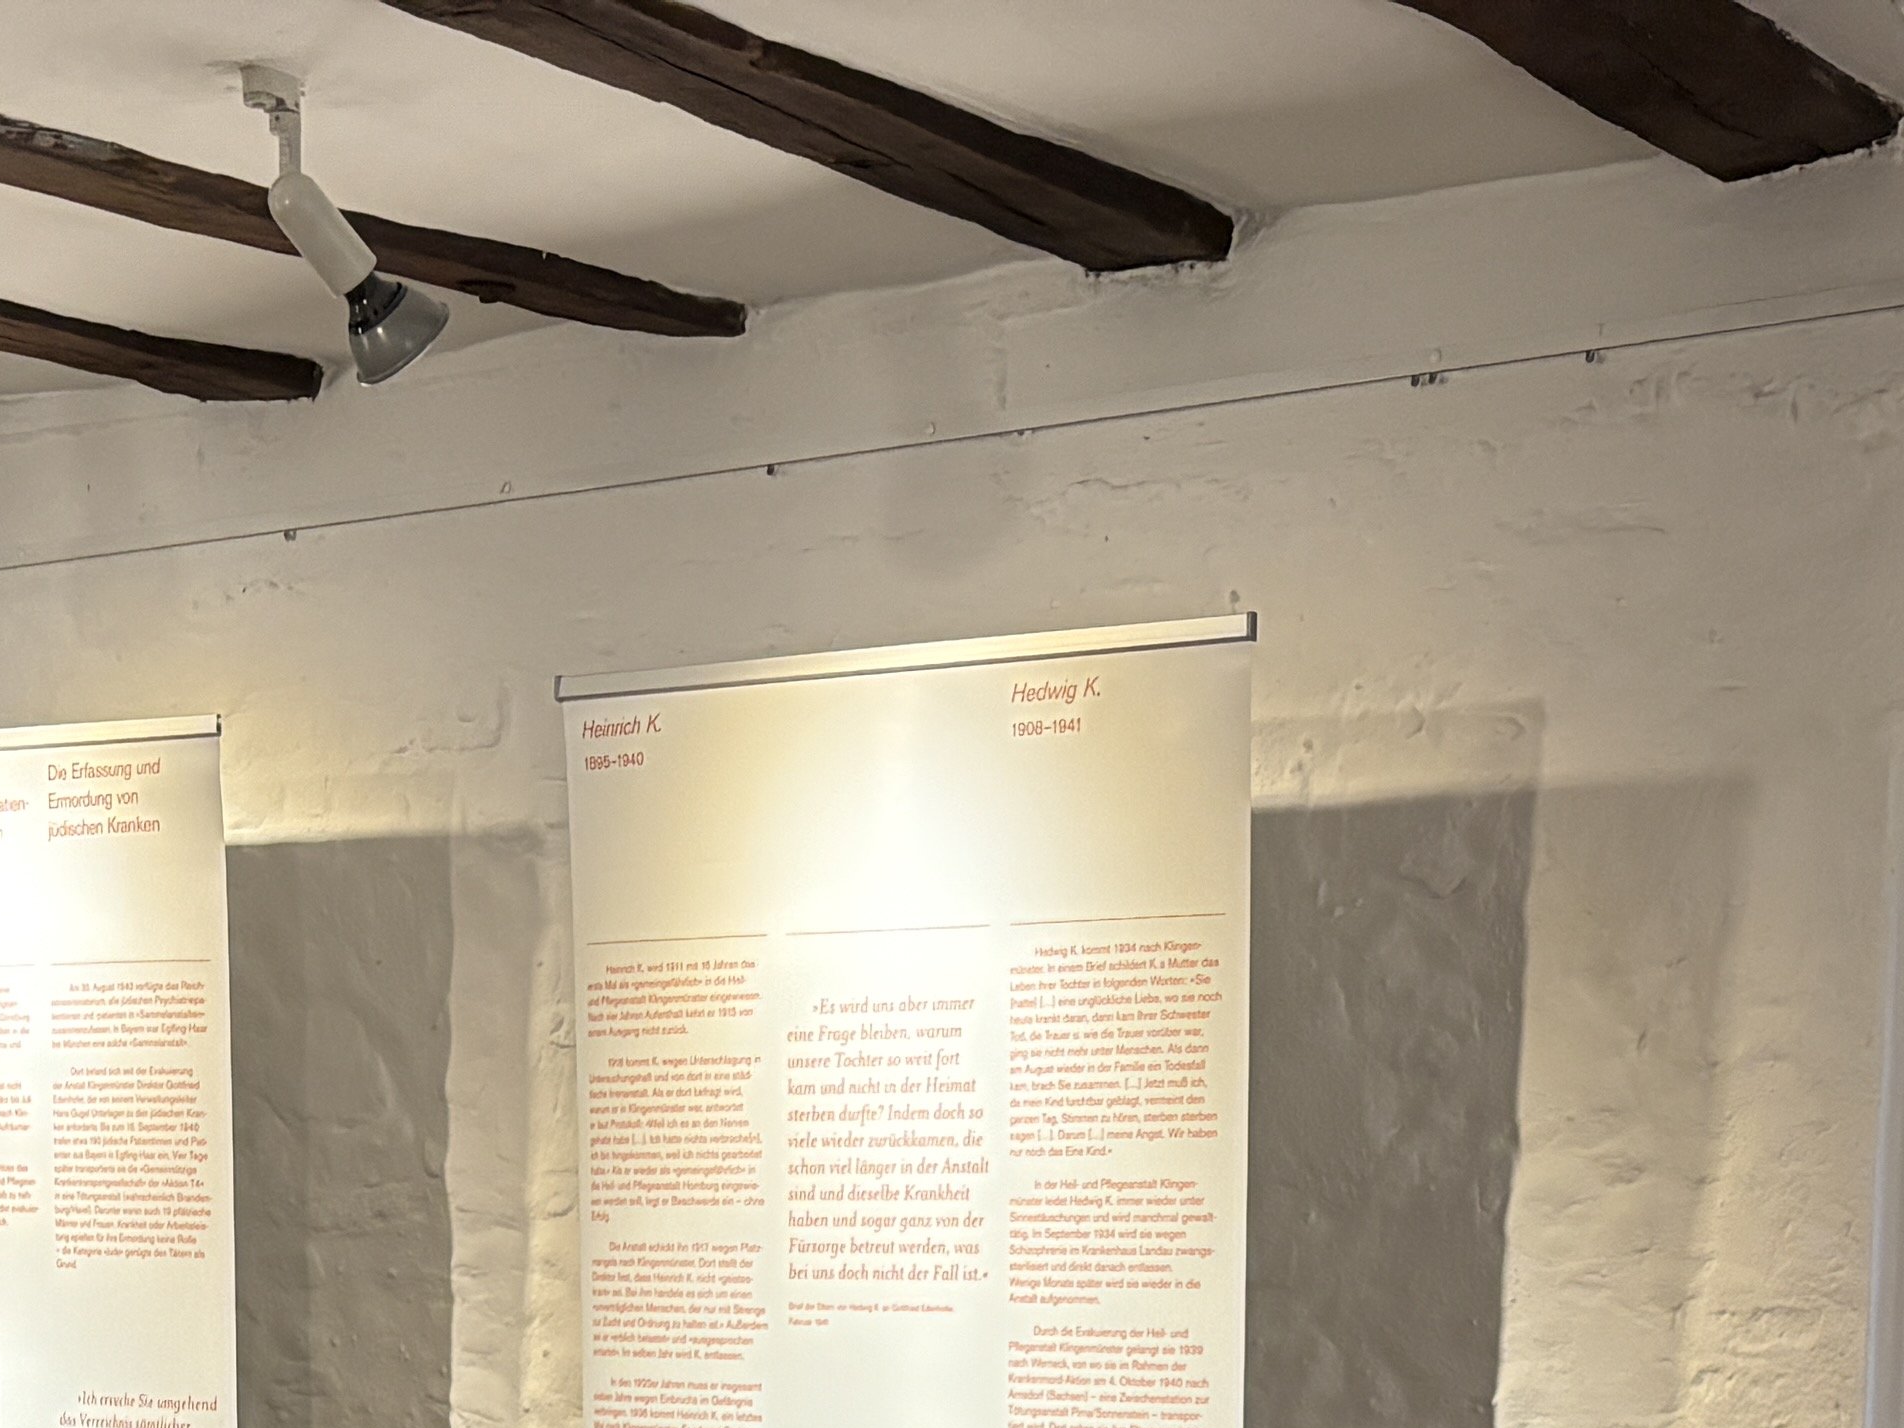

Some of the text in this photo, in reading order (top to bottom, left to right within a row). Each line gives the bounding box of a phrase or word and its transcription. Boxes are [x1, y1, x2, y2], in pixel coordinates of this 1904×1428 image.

[1012, 680, 1077, 703] Hedwig
[582, 717, 641, 739] Heinrich
[1035, 947, 1068, 958] Hedwig
[840, 996, 869, 1014] wird
[872, 1002, 894, 1013] uns
[898, 995, 927, 1012] aber
[932, 999, 974, 1011] immer
[787, 1027, 814, 1043] eine
[818, 1025, 856, 1046] Frage
[916, 1027, 962, 1039] warum
[787, 1048, 960, 1071] unsere Tochter so weit fort
[787, 1076, 976, 1096] kam und nicht in der Heimat
[787, 1102, 984, 1127] sterben durfte? Indem doch so
[788, 1131, 818, 1149] viele
[821, 1131, 864, 1148] wieder
[963, 1129, 983, 1147] die
[788, 1156, 989, 1180] schon viel länger in der Anstalt
[788, 1184, 970, 1202] sind und dieselbe Krankheit
[1069, 1195, 1103, 1209] Hedwig
[788, 1210, 984, 1233] haben und sogar ganz von der
[789, 1237, 980, 1255] Fürsorge betreut werden, was
[788, 1262, 808, 1280] bei
[812, 1268, 834, 1280] uns
[838, 1263, 868, 1281] doch
[872, 1264, 904, 1281] nicht
[908, 1263, 928, 1281] der
[933, 1263, 959, 1281] Fall
